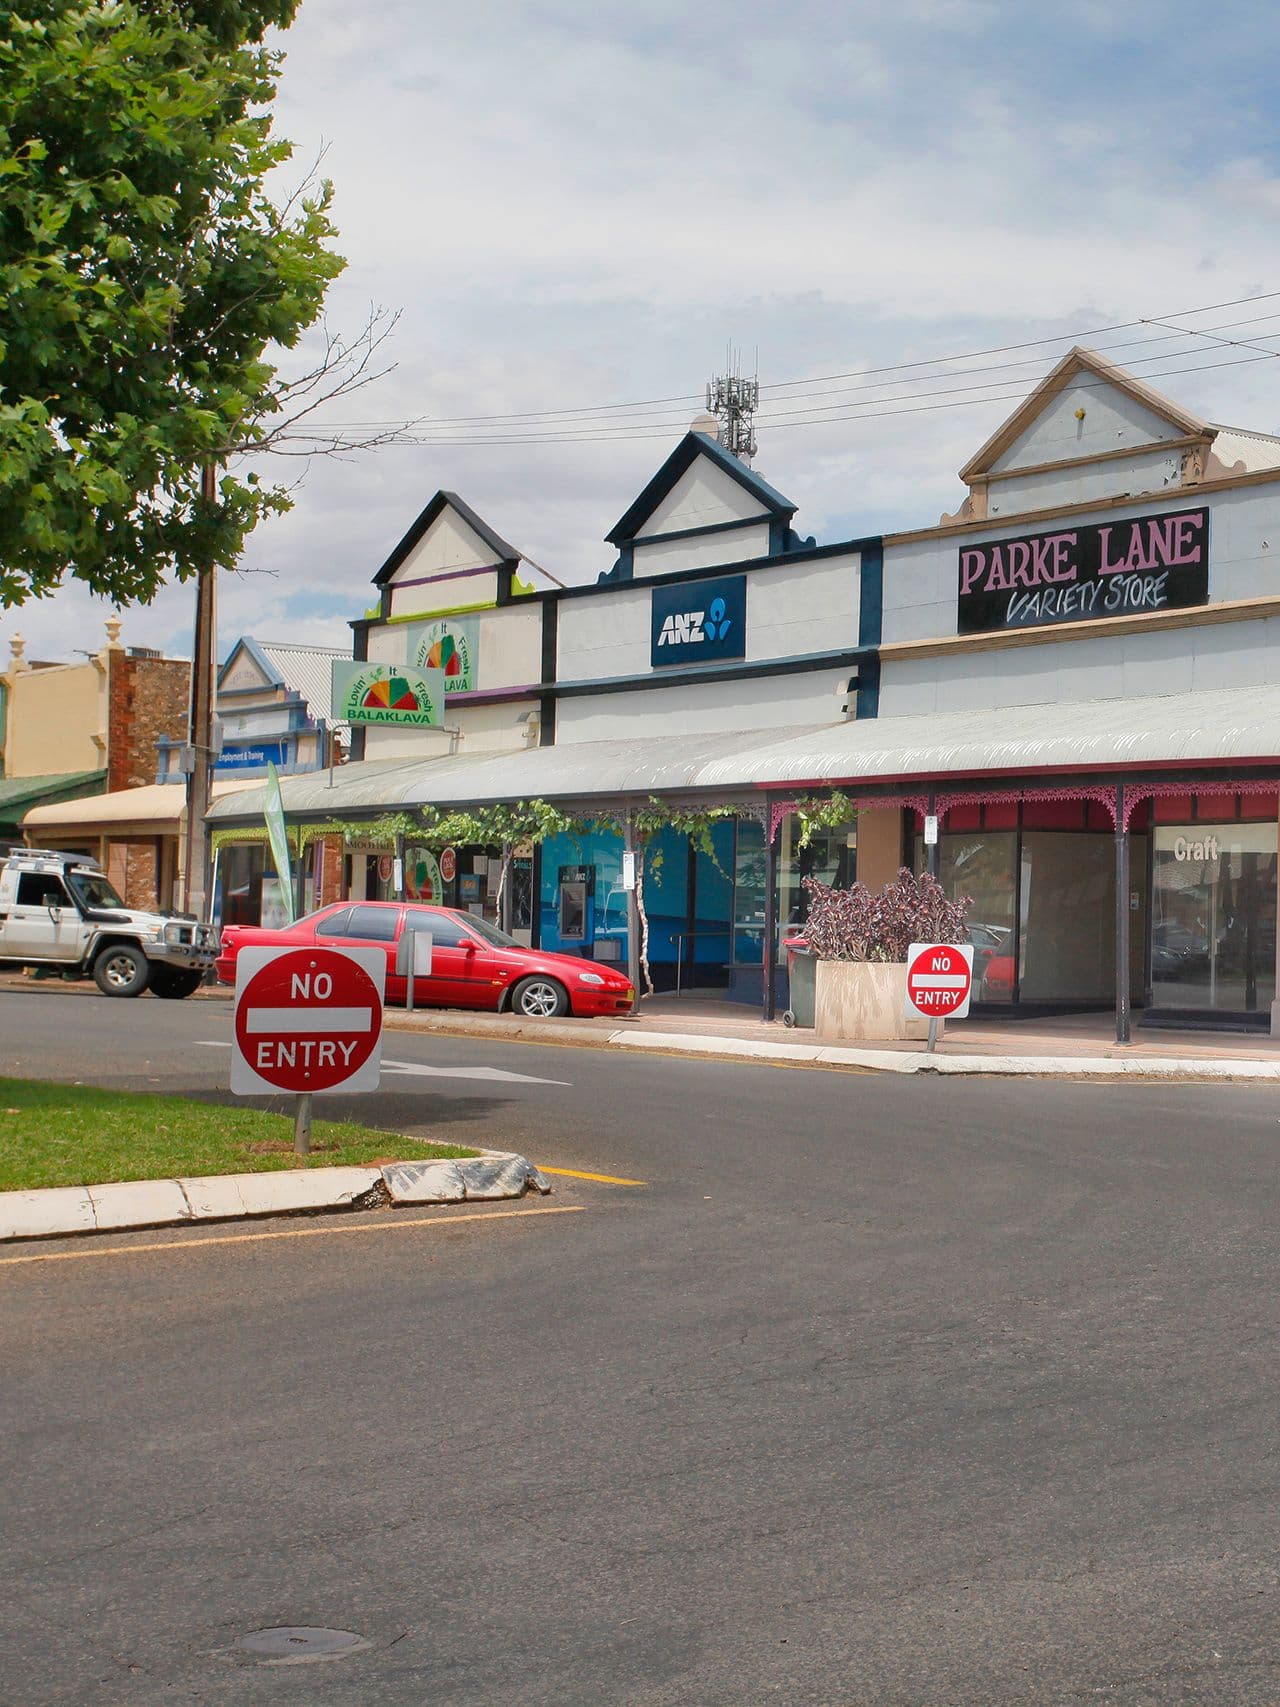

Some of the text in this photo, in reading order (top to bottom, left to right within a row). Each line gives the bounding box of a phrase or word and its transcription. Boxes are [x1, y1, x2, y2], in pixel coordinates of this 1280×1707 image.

[959, 512, 1204, 595] PARKE LANE
[1006, 571, 1169, 623] VARIETY STORE
[657, 611, 705, 646] ANZ
[458, 636, 470, 675] Fresh
[347, 675, 367, 707] Lovin'
[389, 666, 397, 676] It
[415, 681, 433, 713] Fresh
[347, 709, 431, 724] BALAKLAVA
[1174, 836, 1218, 861] Craft
[931, 957, 951, 971] NO
[290, 972, 333, 1000] NO
[915, 991, 960, 1005] ENTRY
[257, 1040, 358, 1068] ENTRY
